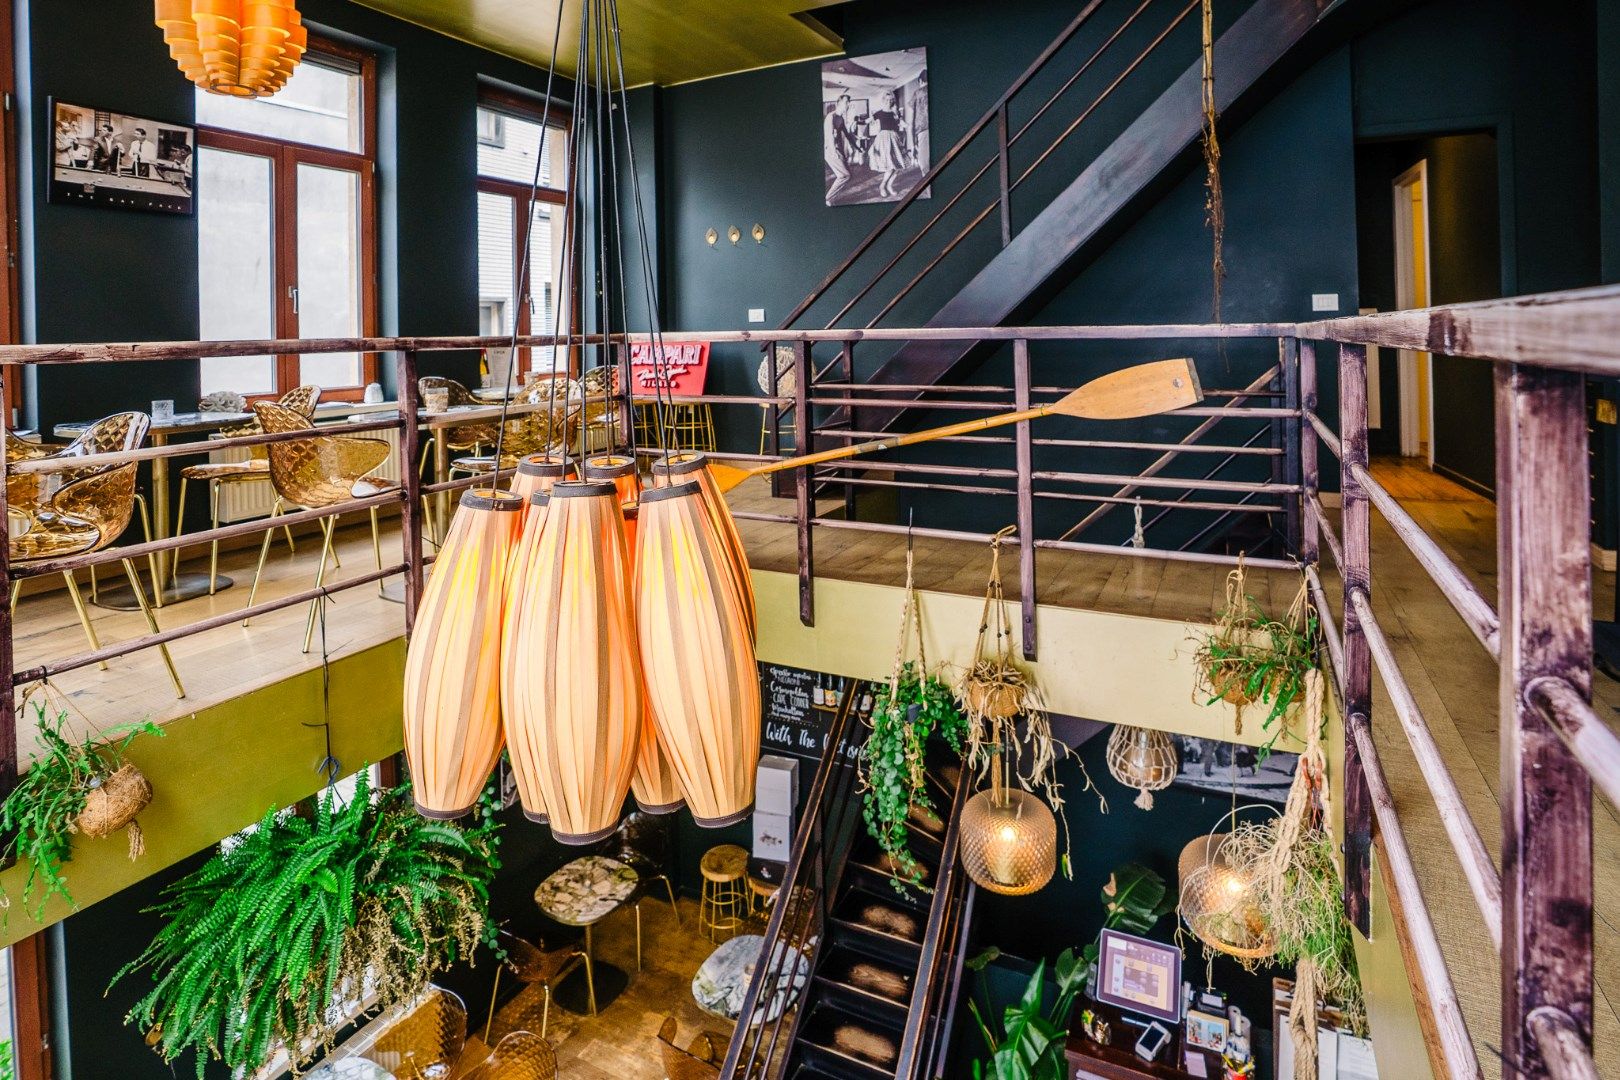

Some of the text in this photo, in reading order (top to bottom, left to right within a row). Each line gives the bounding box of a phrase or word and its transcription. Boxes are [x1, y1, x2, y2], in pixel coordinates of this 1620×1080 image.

[631, 345, 701, 365] CAMPARI
[766, 722, 792, 745] With
[799, 729, 816, 748] The
